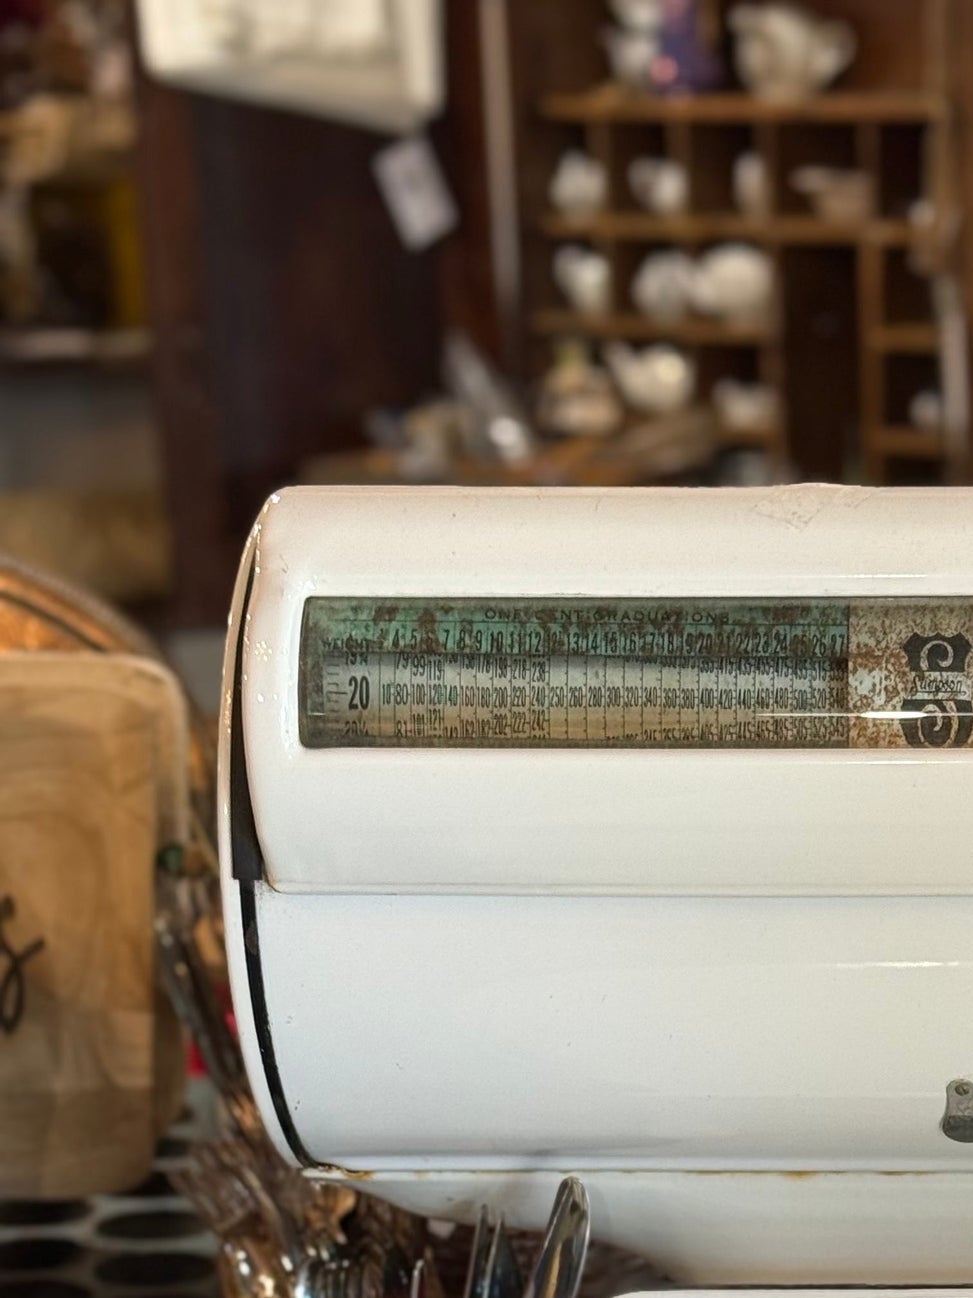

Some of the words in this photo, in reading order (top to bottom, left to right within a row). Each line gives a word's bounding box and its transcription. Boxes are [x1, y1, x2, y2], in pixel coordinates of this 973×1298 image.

[444, 629, 450, 650] 7
[476, 630, 482, 652] 9
[490, 630, 504, 652] 10
[528, 631, 542, 653] 12
[412, 655, 426, 677] 99
[348, 676, 370, 710] 20
[395, 684, 408, 706] 80
[412, 684, 426, 706] 100
[428, 684, 442, 706] 120
[444, 685, 458, 707] 140
[462, 686, 475, 708] 160
[478, 686, 491, 708] 180
[494, 686, 508, 709] 200
[513, 686, 526, 708] 220
[532, 686, 546, 707] 240
[550, 686, 565, 708] 250
[569, 686, 583, 708] 260
[588, 686, 602, 708] 280
[606, 686, 621, 708] 300
[625, 686, 639, 708] 320
[644, 686, 658, 708] 340
[662, 688, 676, 709] 360
[681, 688, 695, 710] 380
[700, 688, 714, 709] 400
[719, 688, 733, 710] 420
[738, 688, 752, 710] 440
[774, 688, 789, 710] 480
[812, 688, 826, 710] 520
[513, 712, 526, 734] 222
